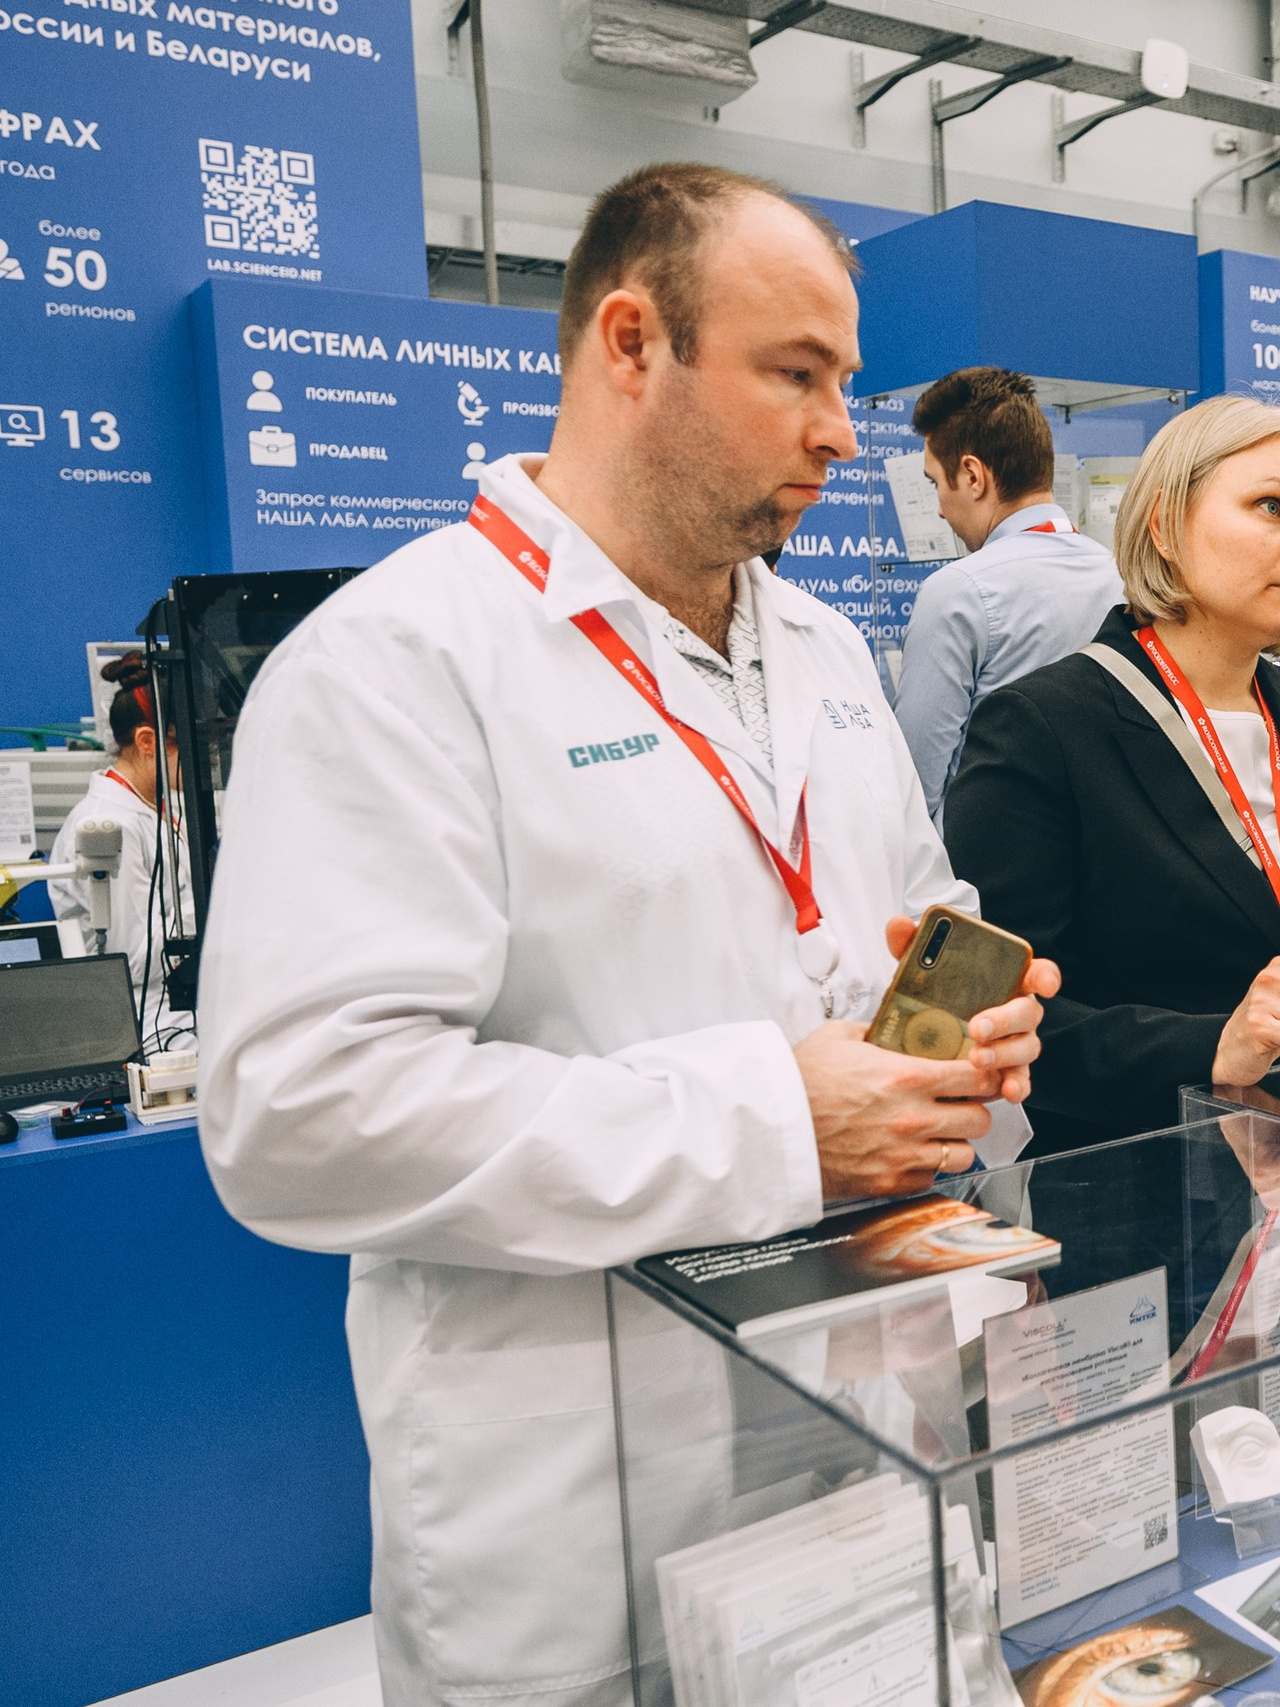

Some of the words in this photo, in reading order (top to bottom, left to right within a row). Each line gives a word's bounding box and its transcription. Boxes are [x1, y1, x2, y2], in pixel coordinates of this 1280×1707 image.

[166, 2, 381, 62] материалов,
[115, 30, 135, 52] и
[147, 30, 311, 82] Беларуси
[38, 220, 101, 241] более
[44, 247, 107, 291] 50
[207, 258, 322, 281] LAB.SCIENCEID.NET
[46, 302, 136, 323] регионов
[242, 325, 389, 361] СИСТЕМА
[395, 339, 512, 371] ЛИЧНЫХ
[305, 386, 397, 406] ПОКУПАТЕЛЬ
[60, 410, 121, 452] 13
[309, 443, 389, 461] ПРОДАВЕЦ
[60, 468, 152, 485] сервисов
[256, 488, 326, 508] Запрос
[329, 494, 469, 513] коммерческого
[257, 509, 315, 526] НАША
[319, 511, 369, 528] ЛАБА
[1150, 645, 1180, 686] РОСКОНГРЕСС
[567, 733, 660, 768] СИБУР
[1200, 723, 1229, 774] ROSCONGRESS
[1246, 816, 1274, 869] РОСКОНГРЕСС
